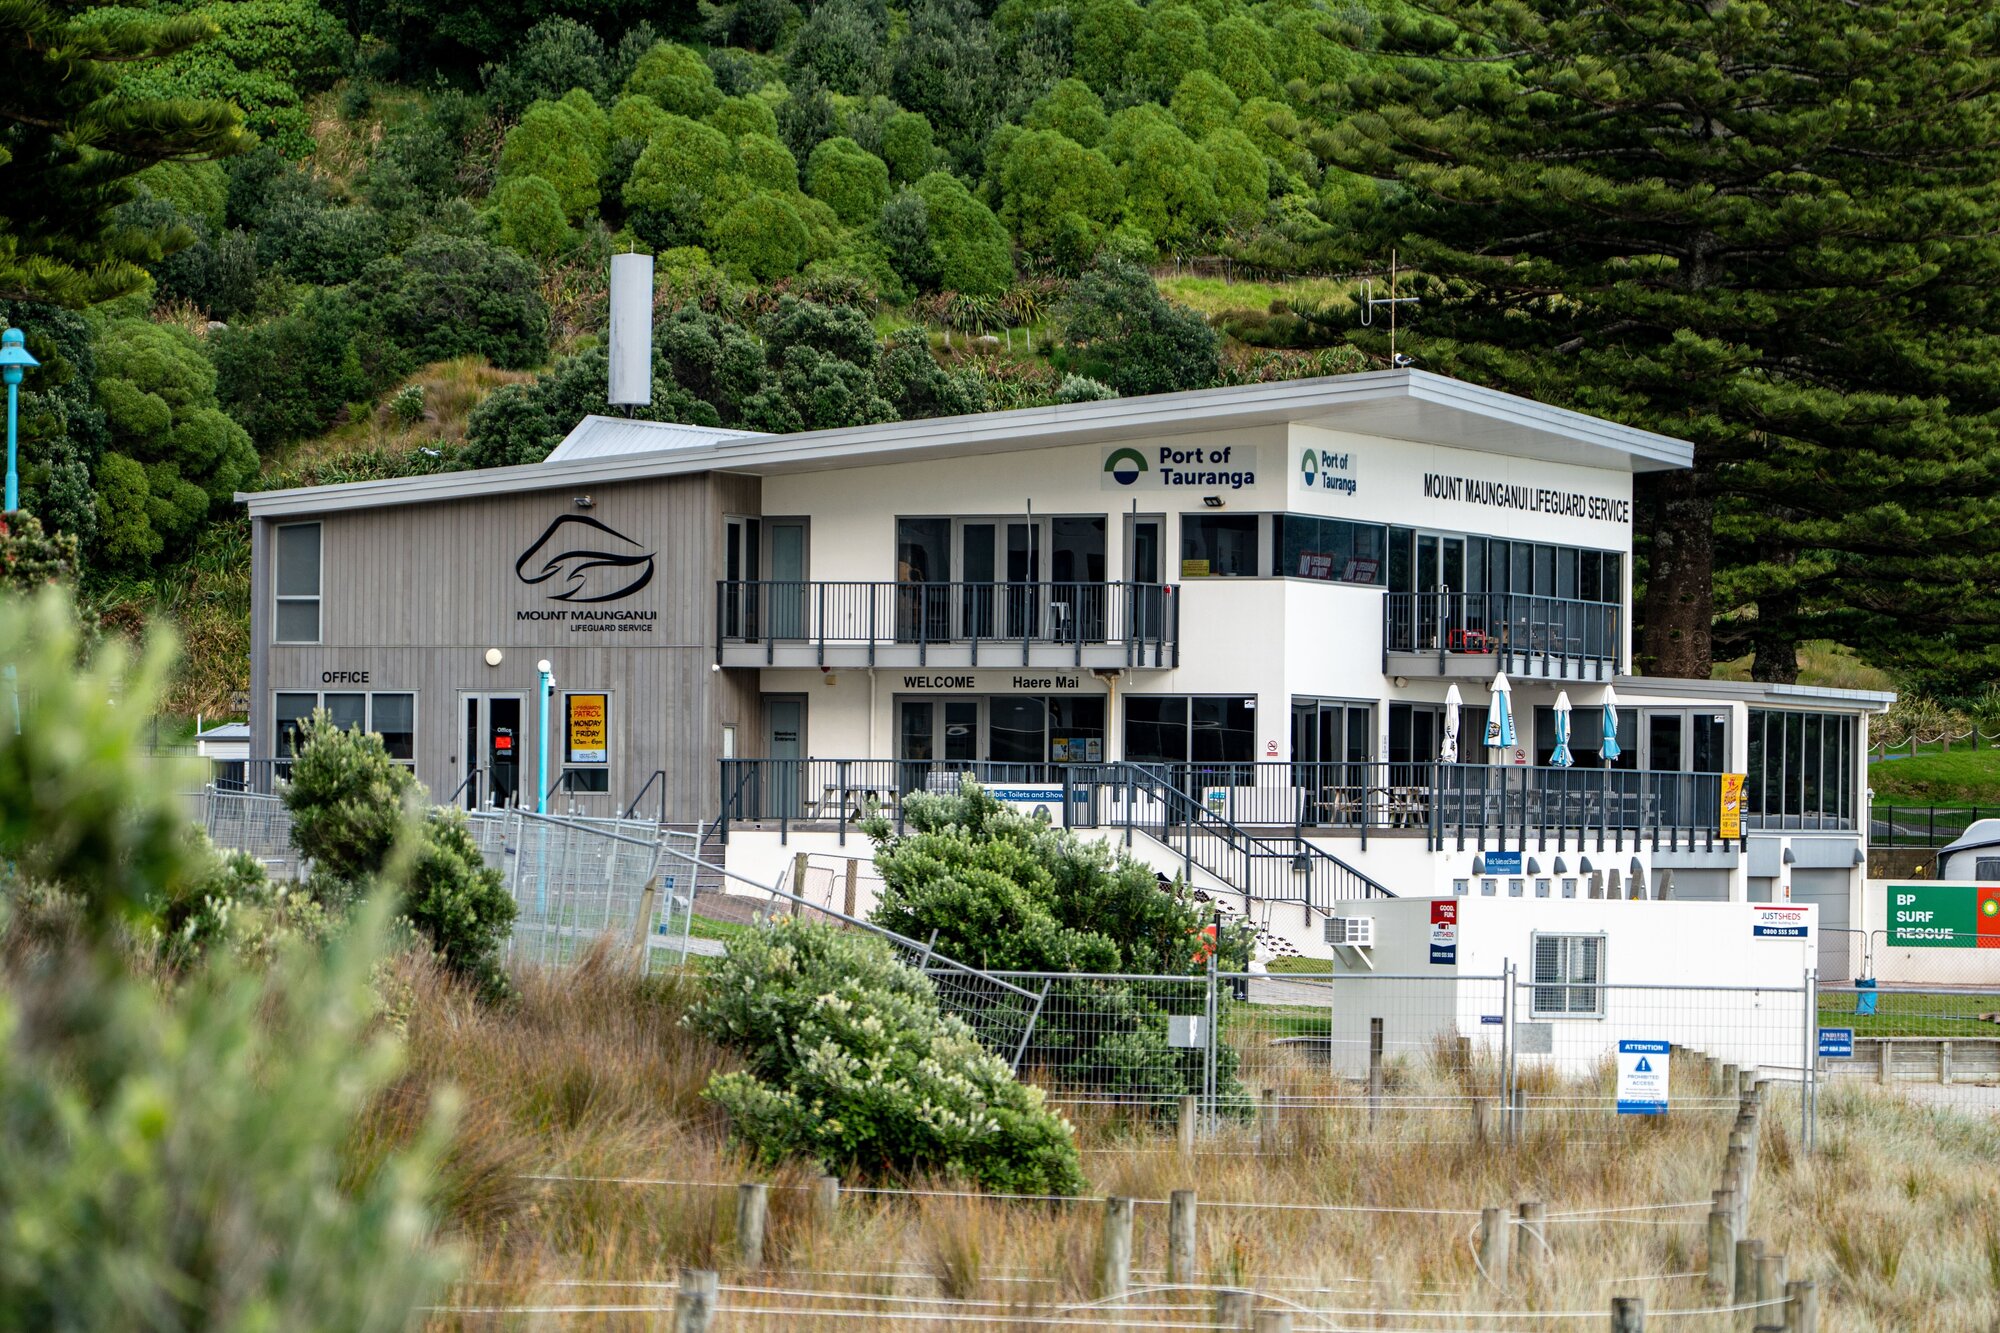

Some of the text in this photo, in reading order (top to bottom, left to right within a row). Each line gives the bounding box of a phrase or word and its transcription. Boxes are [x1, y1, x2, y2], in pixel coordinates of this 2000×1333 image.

[1160, 446, 1231, 464] Port of
[1322, 450, 1348, 470] Port of
[1160, 468, 1254, 489] Tauranga
[1322, 472, 1356, 496] Tauranga
[1424, 473, 1628, 523] MOUNT MAUNGANUI LIFEGUARD SERVICE
[1299, 555, 1310, 576] NO
[517, 610, 657, 620] MOUNT MAUNGANUI
[322, 671, 370, 683] OFFICE
[904, 676, 1079, 688] WELCOME Haere Mai
[1897, 894, 1916, 905] BP
[1896, 911, 1934, 922] SURF
[1897, 927, 1954, 939] RESCUE
